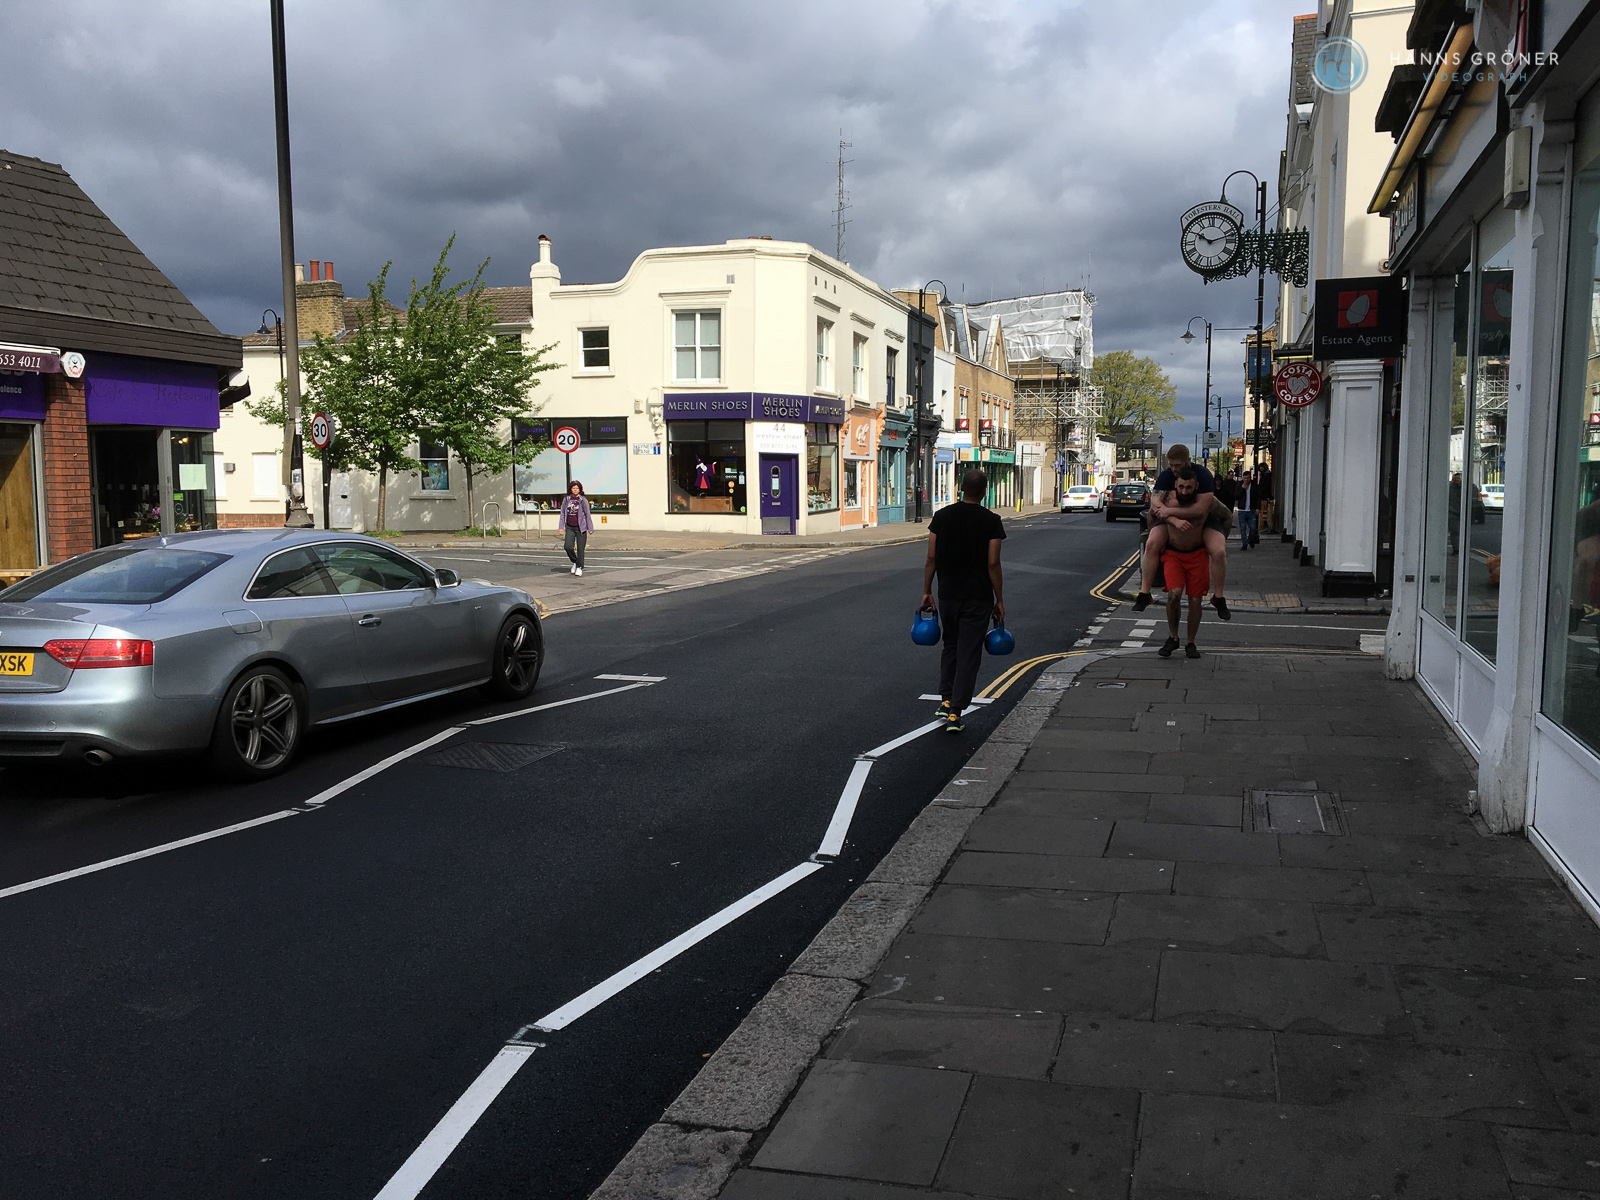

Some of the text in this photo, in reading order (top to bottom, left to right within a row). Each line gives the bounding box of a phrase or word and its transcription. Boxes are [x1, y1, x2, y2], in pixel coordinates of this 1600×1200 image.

[1184, 204, 1240, 221] FORESTERS HALL
[1321, 334, 1393, 346] Estate Agents
[18, 355, 41, 368] 4011
[1282, 365, 1312, 379] COSTA
[1279, 388, 1317, 404] COFFEE
[667, 401, 748, 411] MERLIN SHOES
[762, 397, 803, 408] MERLIN
[764, 406, 801, 417] SHOES
[313, 423, 327, 438] 30
[773, 423, 786, 432] 44
[558, 434, 576, 446] 20
[0, 655, 27, 672] XSK
